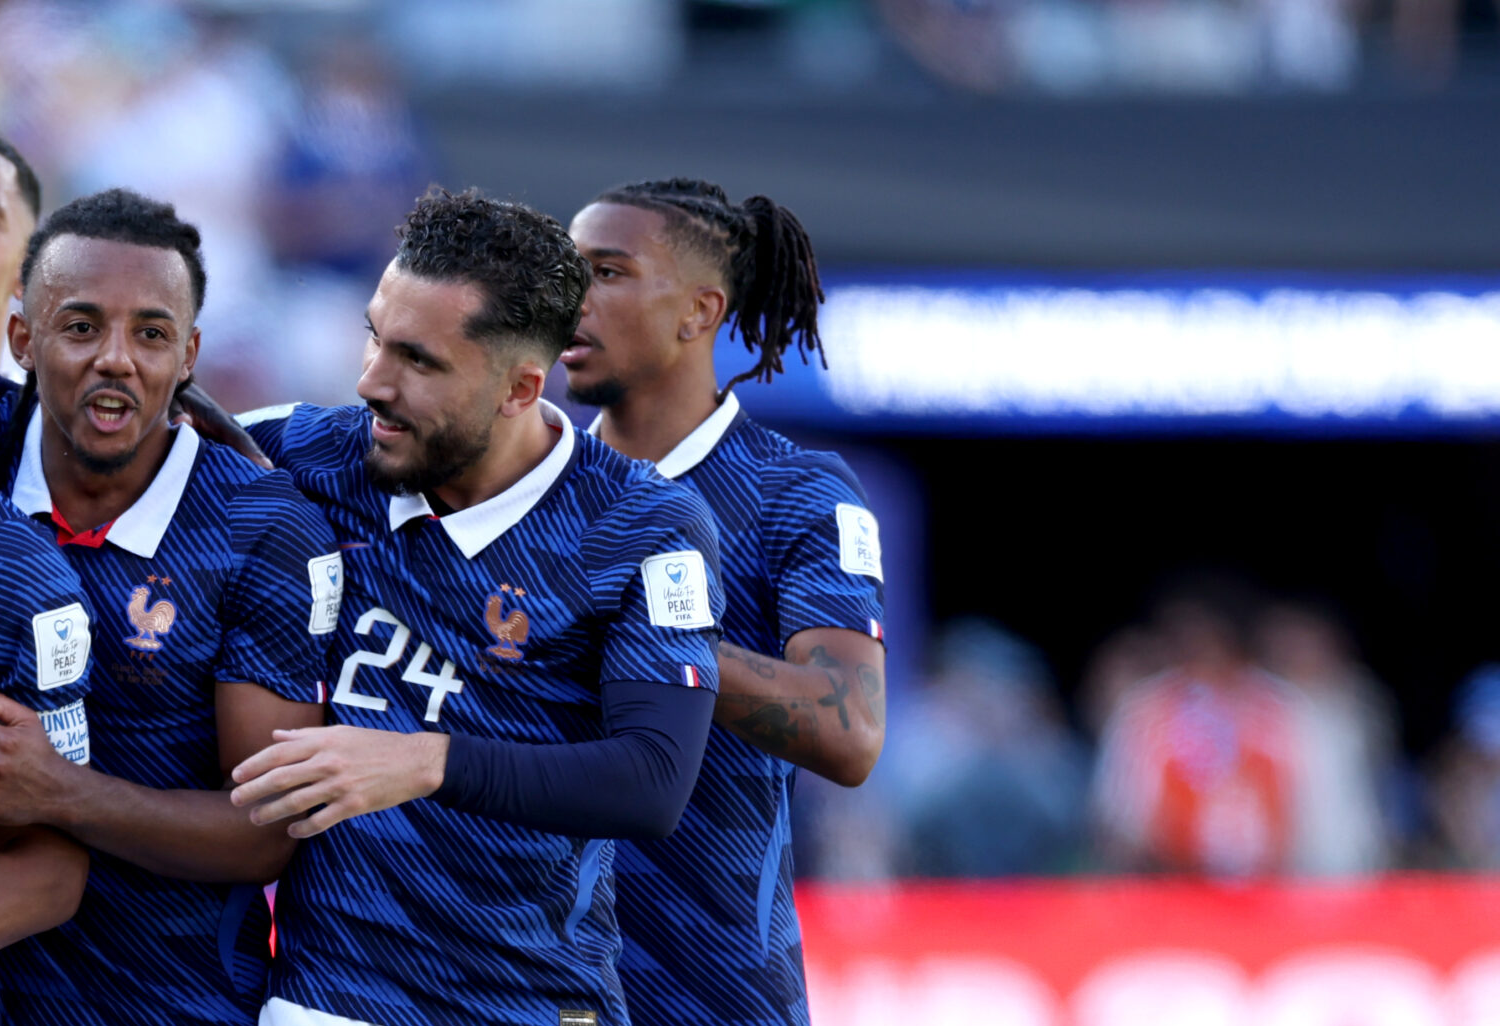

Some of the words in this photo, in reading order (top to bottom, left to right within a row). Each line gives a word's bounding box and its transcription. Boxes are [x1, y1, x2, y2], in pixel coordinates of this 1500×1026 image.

[667, 598, 696, 614] PEACE
[675, 613, 693, 621] FIFA
[54, 652, 77, 671] PEACE
[332, 606, 465, 723] 24
